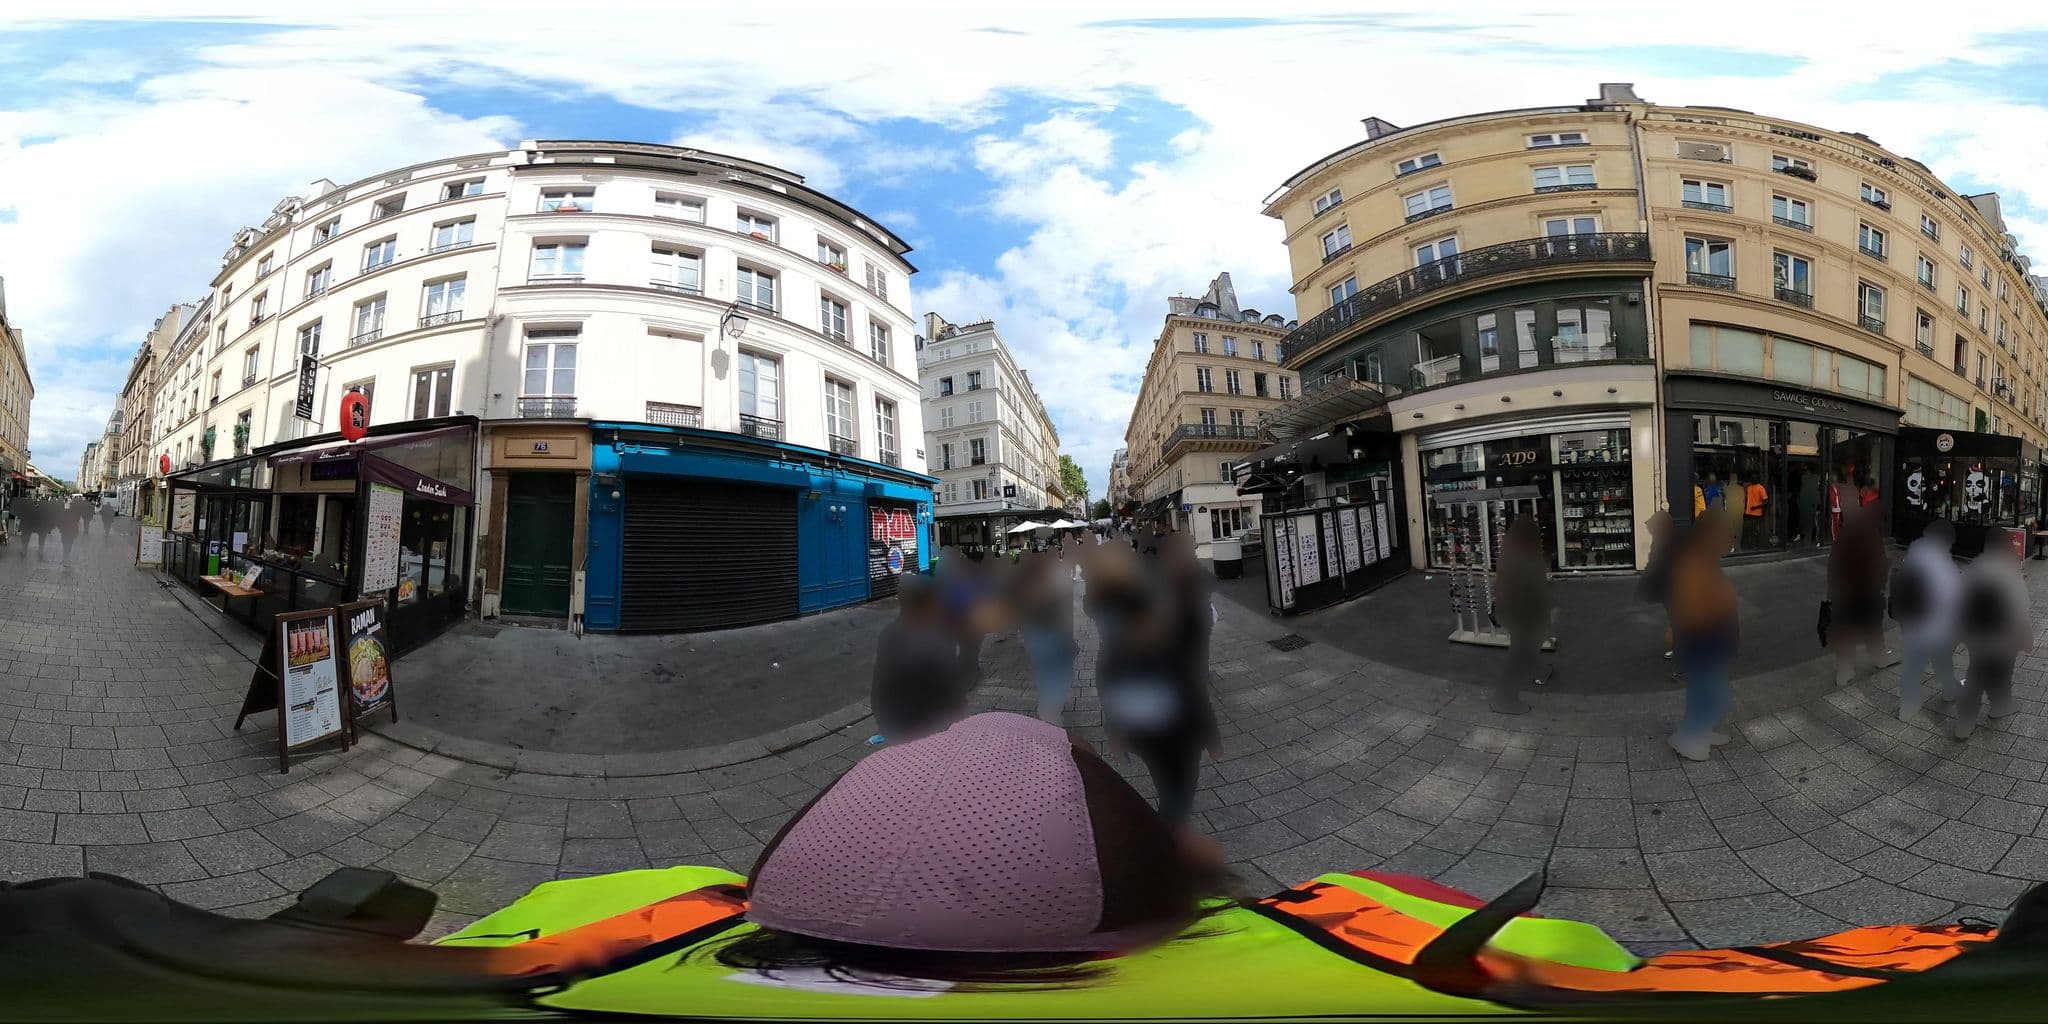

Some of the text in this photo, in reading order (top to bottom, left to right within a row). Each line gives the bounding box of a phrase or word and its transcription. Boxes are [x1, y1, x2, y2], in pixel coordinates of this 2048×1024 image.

[307, 361, 316, 403] SUSHI
[1773, 390, 1808, 405] SAVAGE
[1498, 450, 1536, 466] AD9
[351, 607, 375, 635] RAMAN
